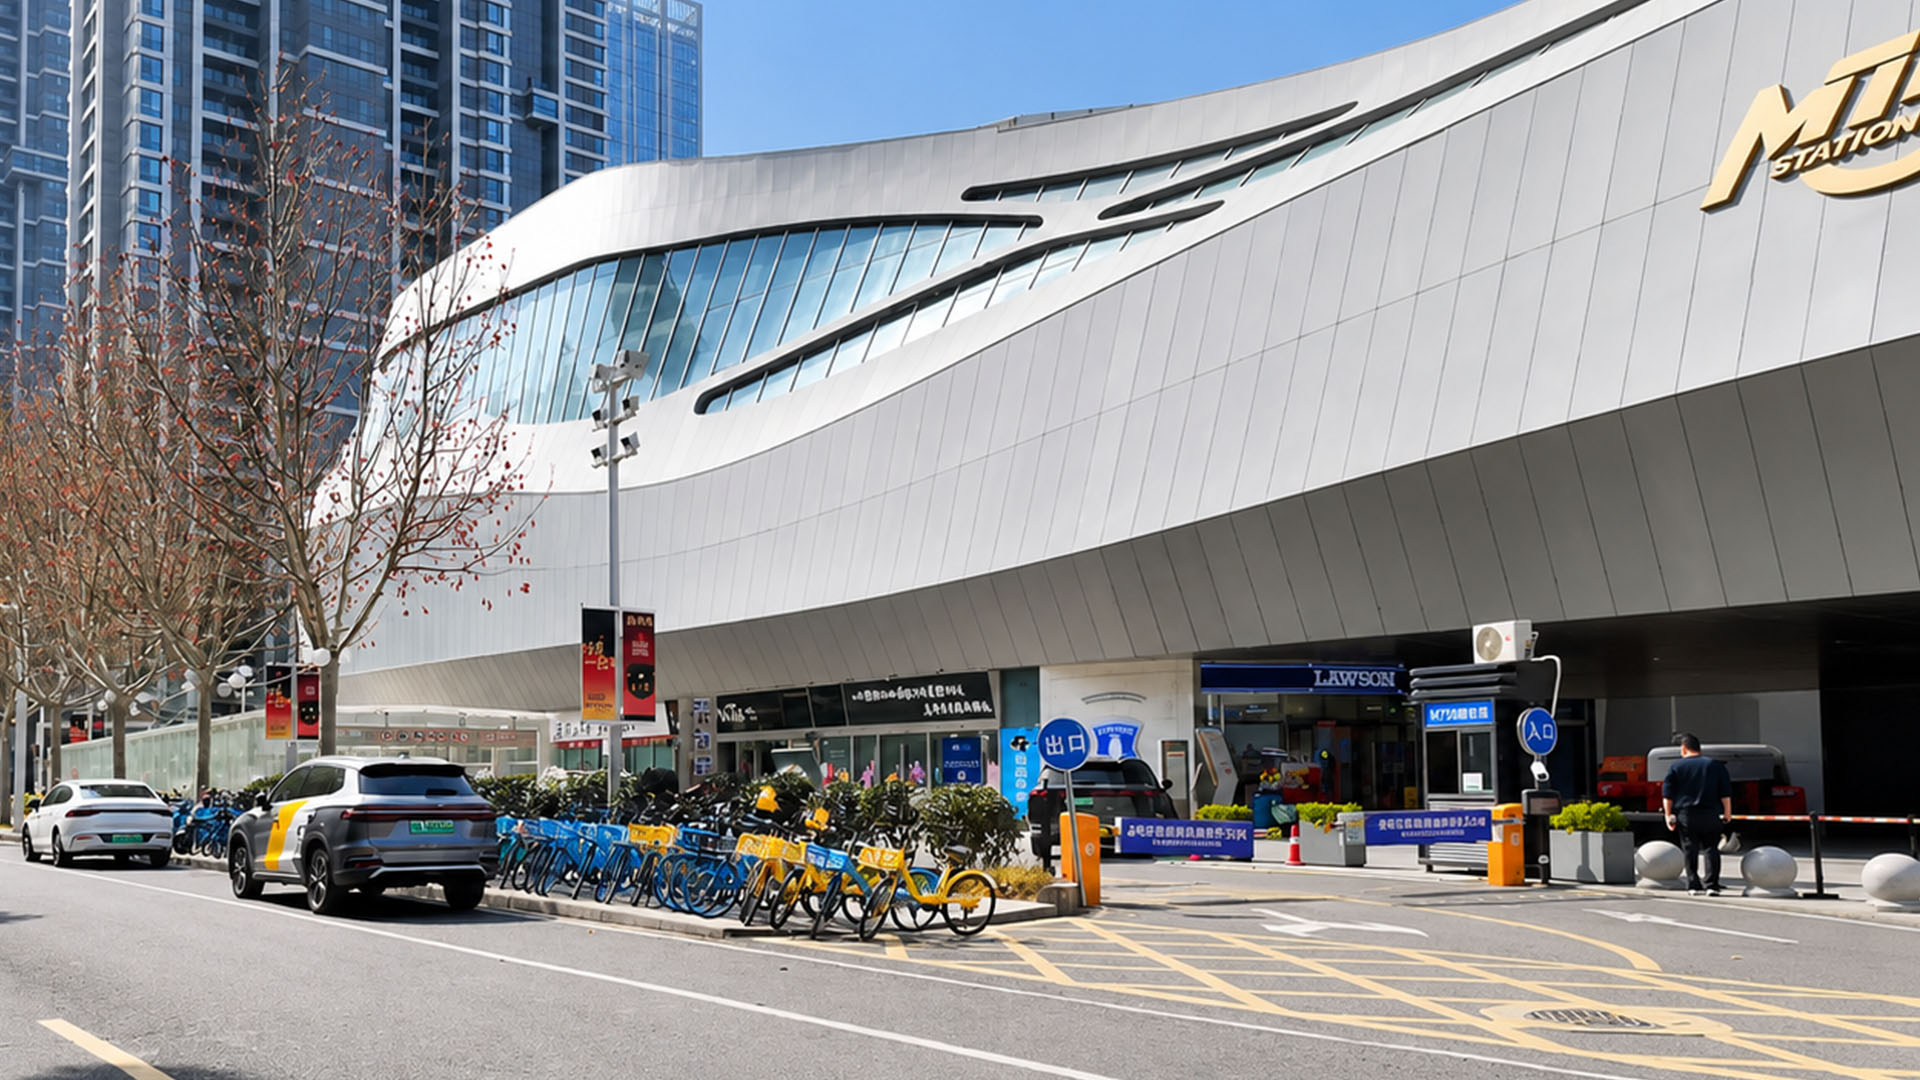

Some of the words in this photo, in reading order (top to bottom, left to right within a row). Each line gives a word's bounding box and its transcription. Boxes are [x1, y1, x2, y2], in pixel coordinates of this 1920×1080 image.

[1769, 112, 1920, 179] STATION
[1313, 669, 1395, 687] LAWSON
[1527, 721, 1554, 741] 入口
[1045, 733, 1086, 756] 出口
